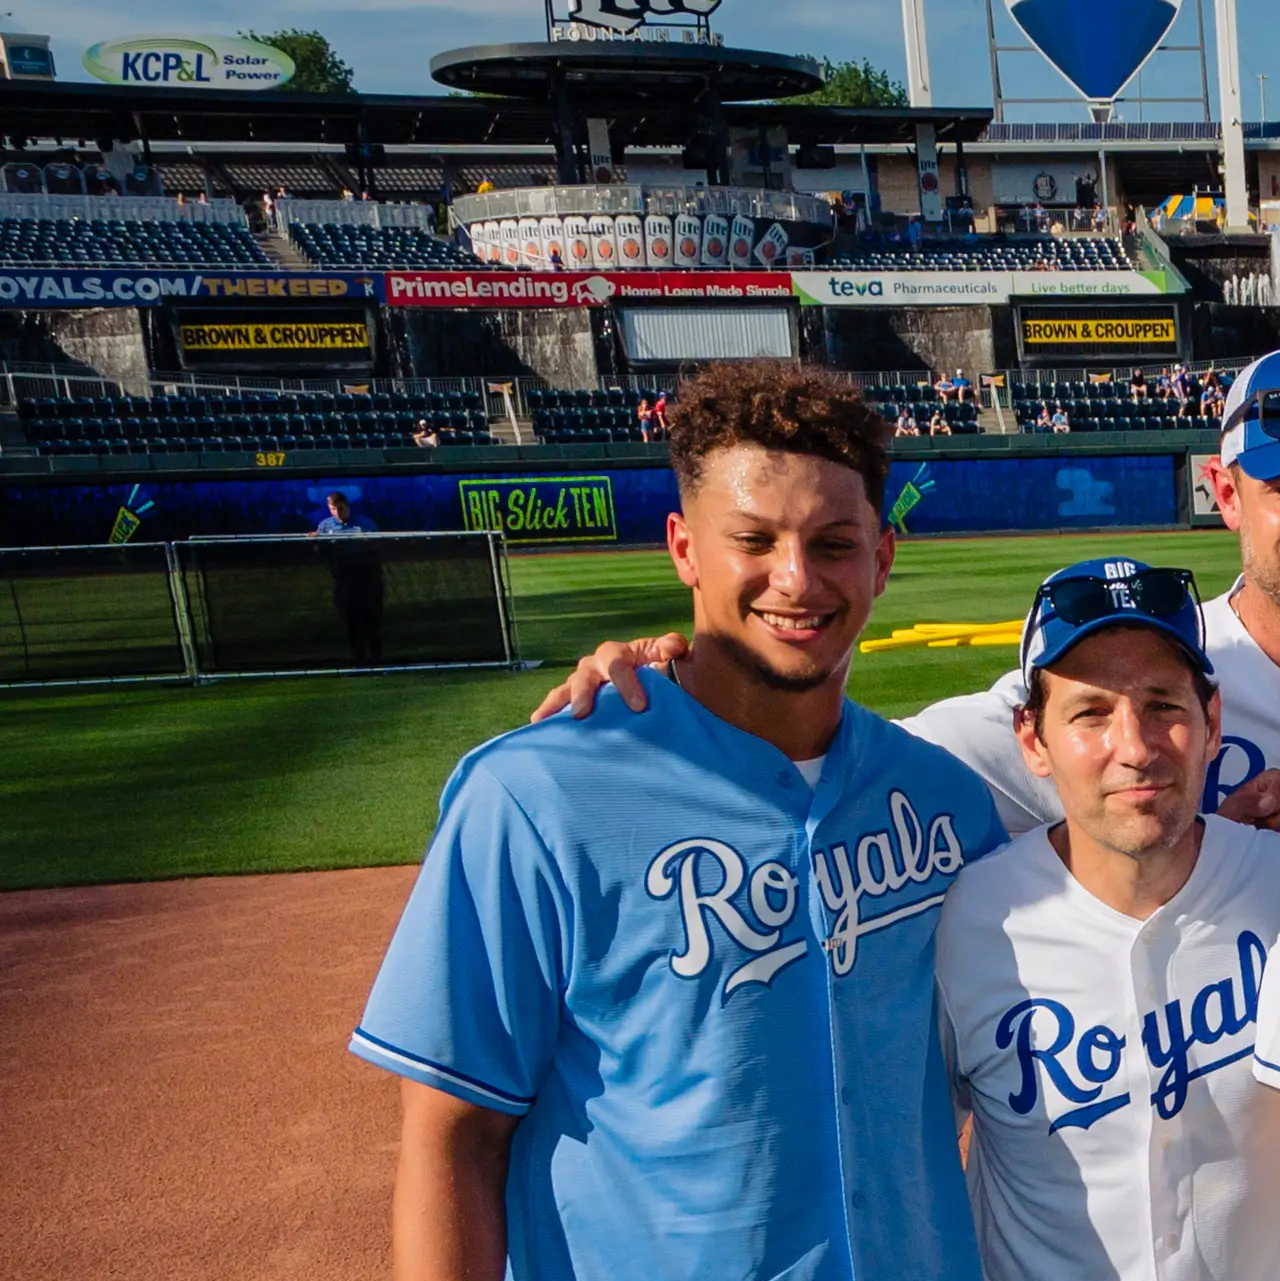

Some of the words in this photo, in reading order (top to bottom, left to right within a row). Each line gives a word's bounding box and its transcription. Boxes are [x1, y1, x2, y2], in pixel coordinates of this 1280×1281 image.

[552, 27, 670, 43] FOUNTAIN
[682, 30, 725, 46] BAR
[122, 52, 210, 82] KCP&L
[223, 55, 269, 66] Solar
[225, 70, 280, 80] Power
[391, 277, 568, 302] PrimeLending
[621, 285, 661, 296] Home
[664, 285, 704, 297] Loans
[706, 286, 741, 297] Made
[829, 277, 883, 297] teva
[893, 282, 998, 294] Pharmaceuticals
[1031, 282, 1057, 293] Live
[1060, 281, 1098, 293] better
[1101, 281, 1131, 294] days
[183, 327, 250, 347] BROWN
[254, 329, 267, 344] &
[274, 325, 366, 346] CROUPPEN
[1023, 323, 1077, 340] BROWN
[1080, 323, 1093, 338] &
[1095, 322, 1170, 339] CROUPPEN
[256, 453, 287, 466] 387
[469, 490, 504, 531] BIG
[507, 487, 569, 530] Slick
[570, 487, 608, 527] TEN
[1105, 562, 1136, 580] BIG
[644, 788, 963, 1005] Royals
[996, 930, 1267, 1136] Royal
